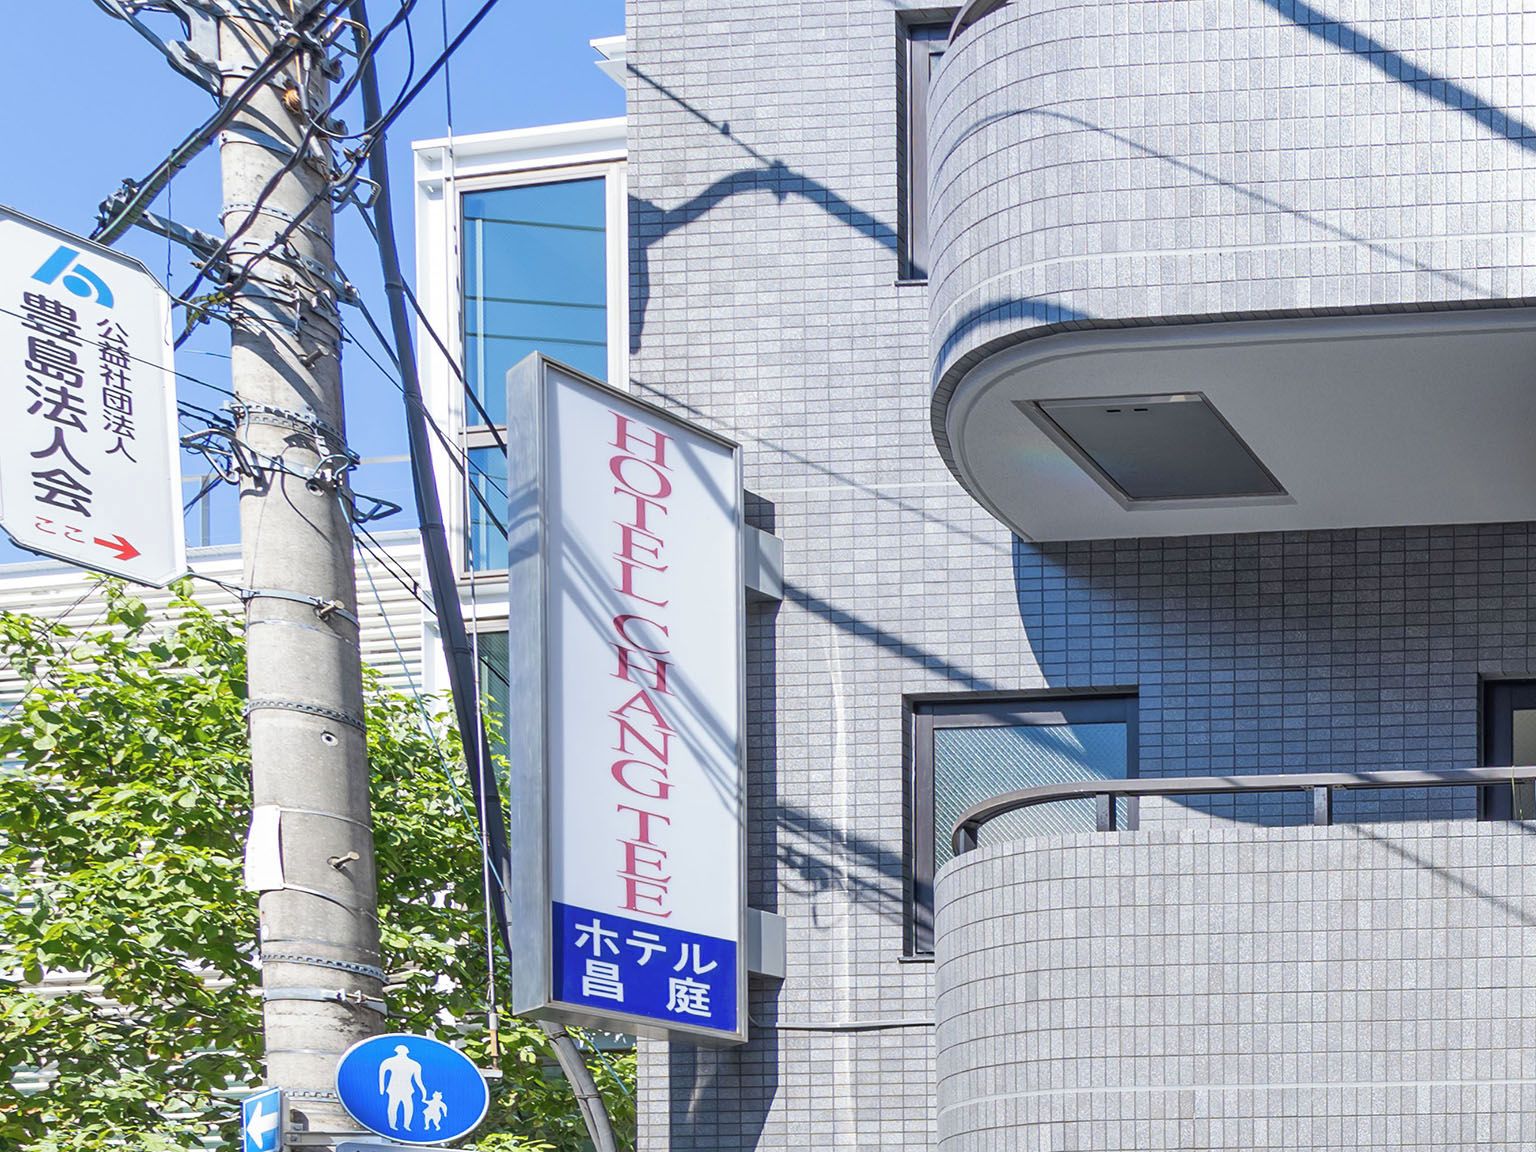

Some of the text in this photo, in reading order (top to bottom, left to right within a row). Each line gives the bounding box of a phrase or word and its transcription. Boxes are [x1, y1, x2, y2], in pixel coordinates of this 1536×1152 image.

[20, 291, 93, 518] 豊島法人会
[97, 318, 138, 464] 公益社団法人
[35, 515, 86, 544] ここ
[607, 410, 675, 609] HOTEL
[575, 918, 718, 975] ホテル
